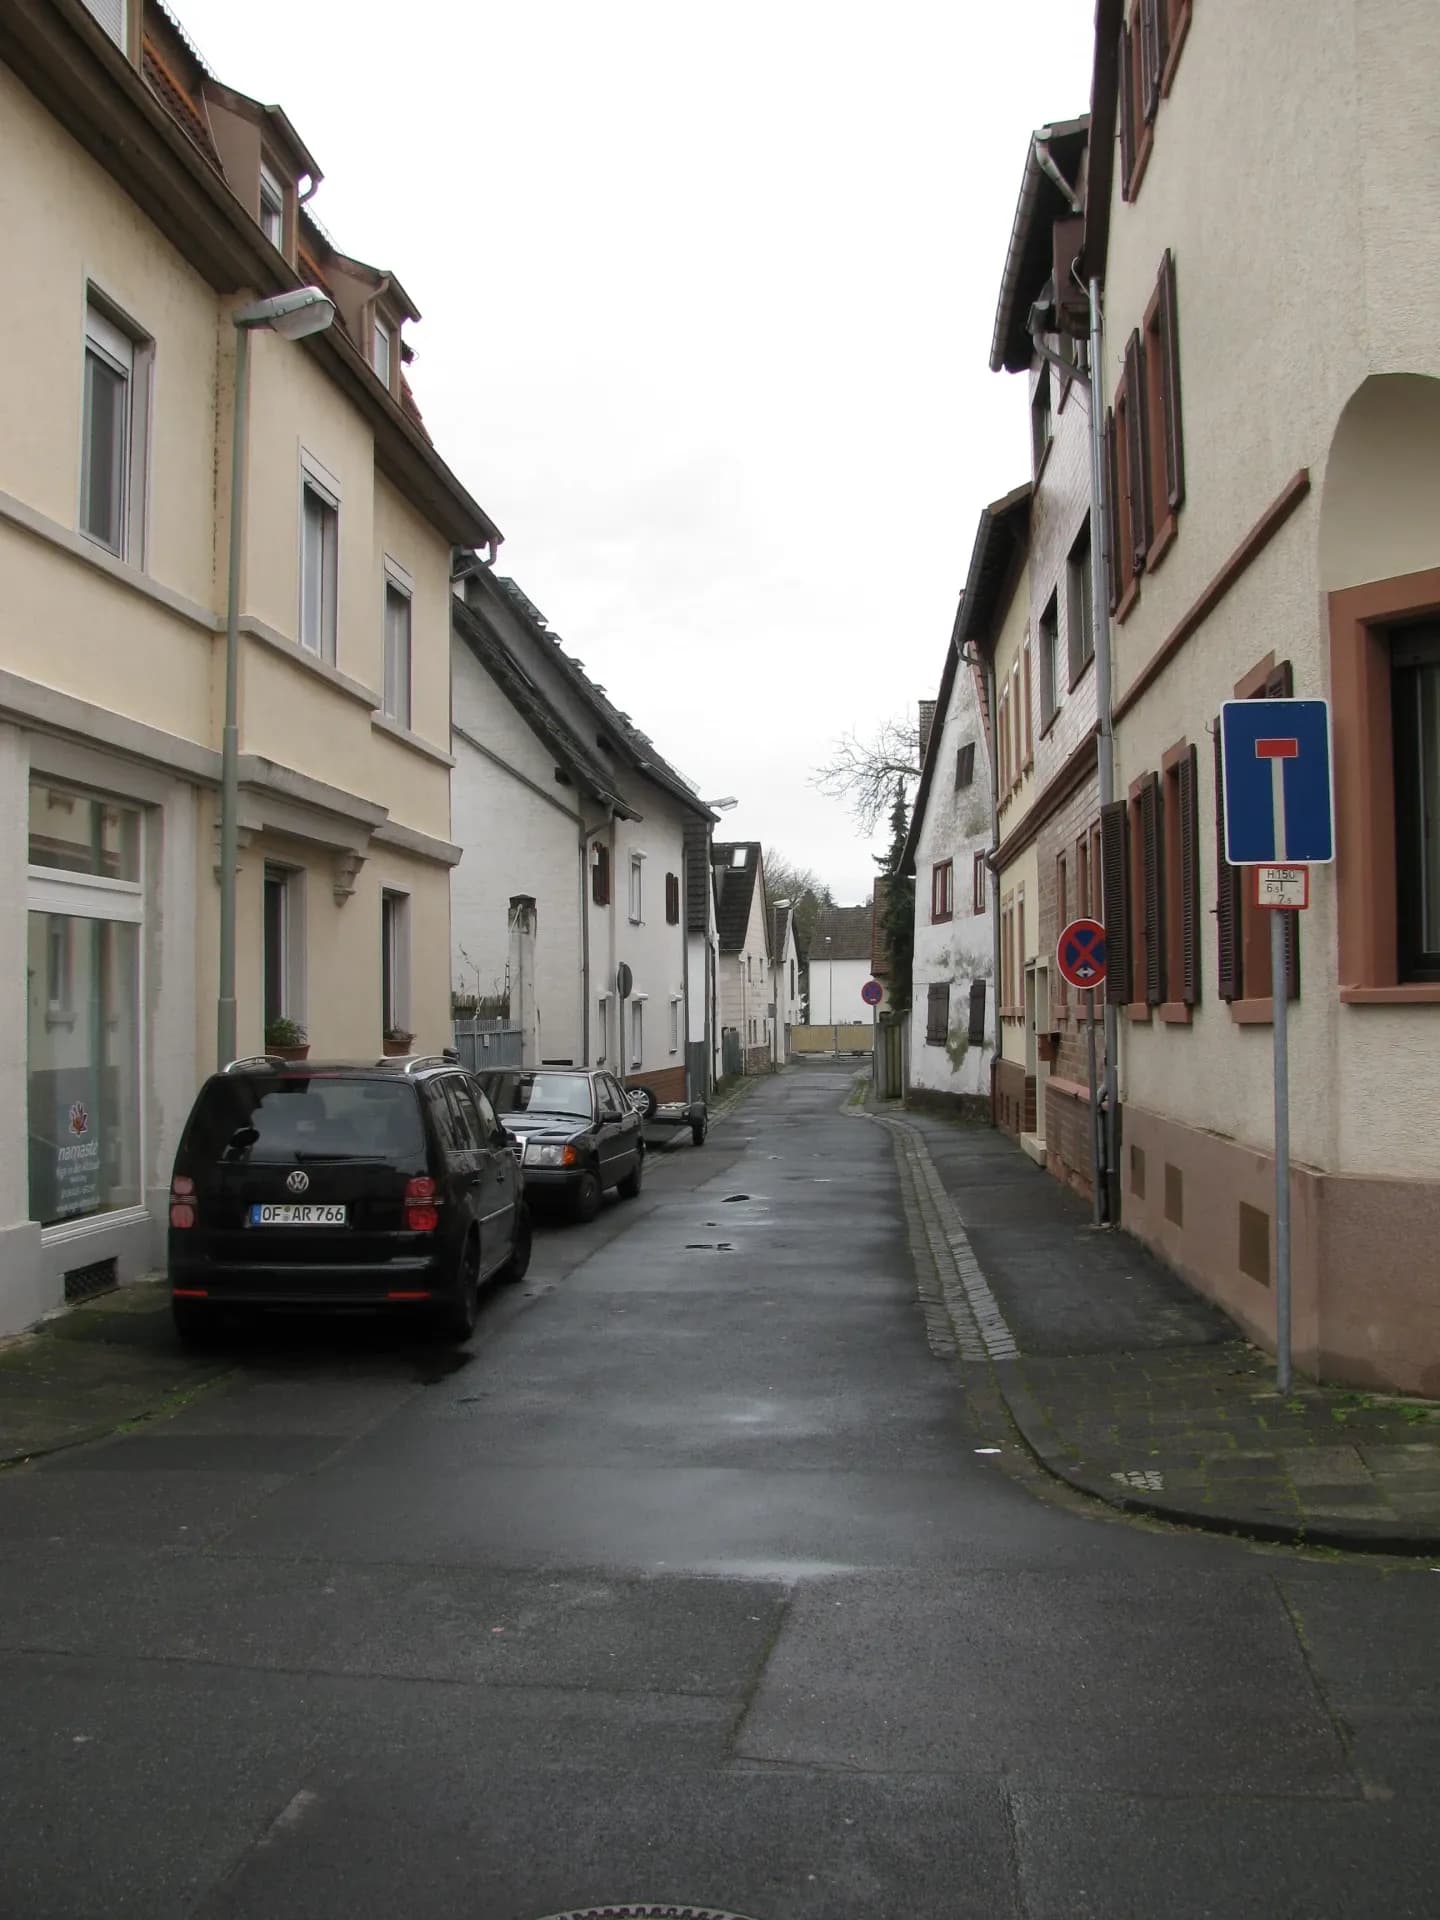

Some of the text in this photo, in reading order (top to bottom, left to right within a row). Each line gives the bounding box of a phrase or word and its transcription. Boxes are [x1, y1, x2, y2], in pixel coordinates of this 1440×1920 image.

[262, 1206, 282, 1221] OF
[292, 1206, 312, 1221] AR
[315, 1206, 344, 1221] 766
